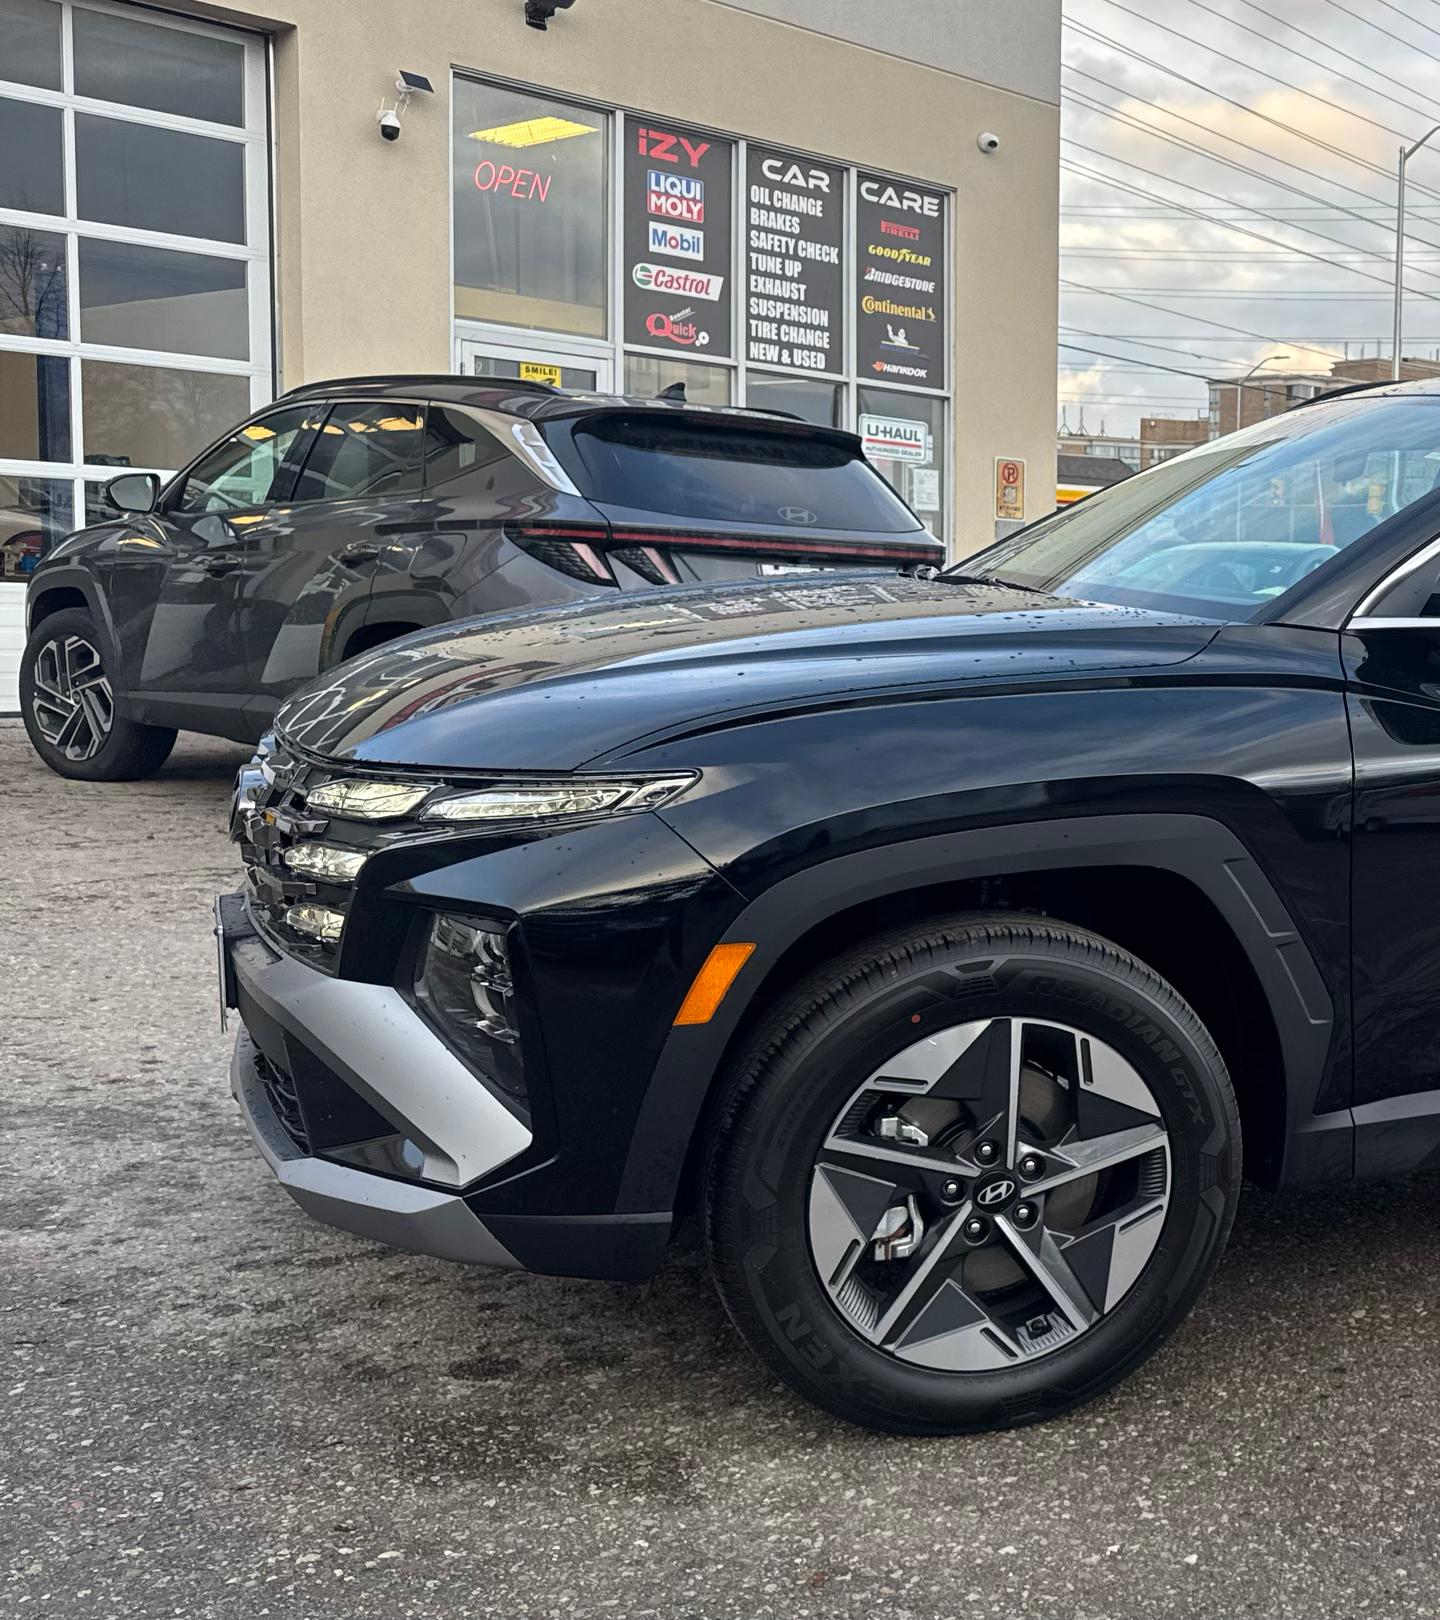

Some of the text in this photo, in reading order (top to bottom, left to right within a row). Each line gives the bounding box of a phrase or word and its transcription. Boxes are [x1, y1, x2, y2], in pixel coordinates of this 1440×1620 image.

[475, 160, 552, 202] OPEN
[650, 172, 701, 201] LIQUI
[762, 159, 830, 193] CAR
[650, 192, 702, 220] MOLY
[750, 184, 823, 217] OIL CHANGE
[860, 181, 940, 218] CARE
[750, 207, 800, 234] BRAKES
[652, 228, 700, 254] Mobil
[750, 229, 839, 265] SAFETY CHECK
[750, 252, 802, 278] TUNE UP
[653, 269, 711, 296] Castrol
[750, 274, 807, 301] EXHAUST
[864, 267, 936, 293] BRIDGESTONE
[750, 296, 829, 328] SUSPENSION
[861, 295, 926, 320] Continental
[646, 313, 697, 345] Quick
[749, 319, 830, 349] TIRE CHANGE
[750, 341, 826, 370] NEW & USED
[867, 423, 921, 442] U-HAUL
